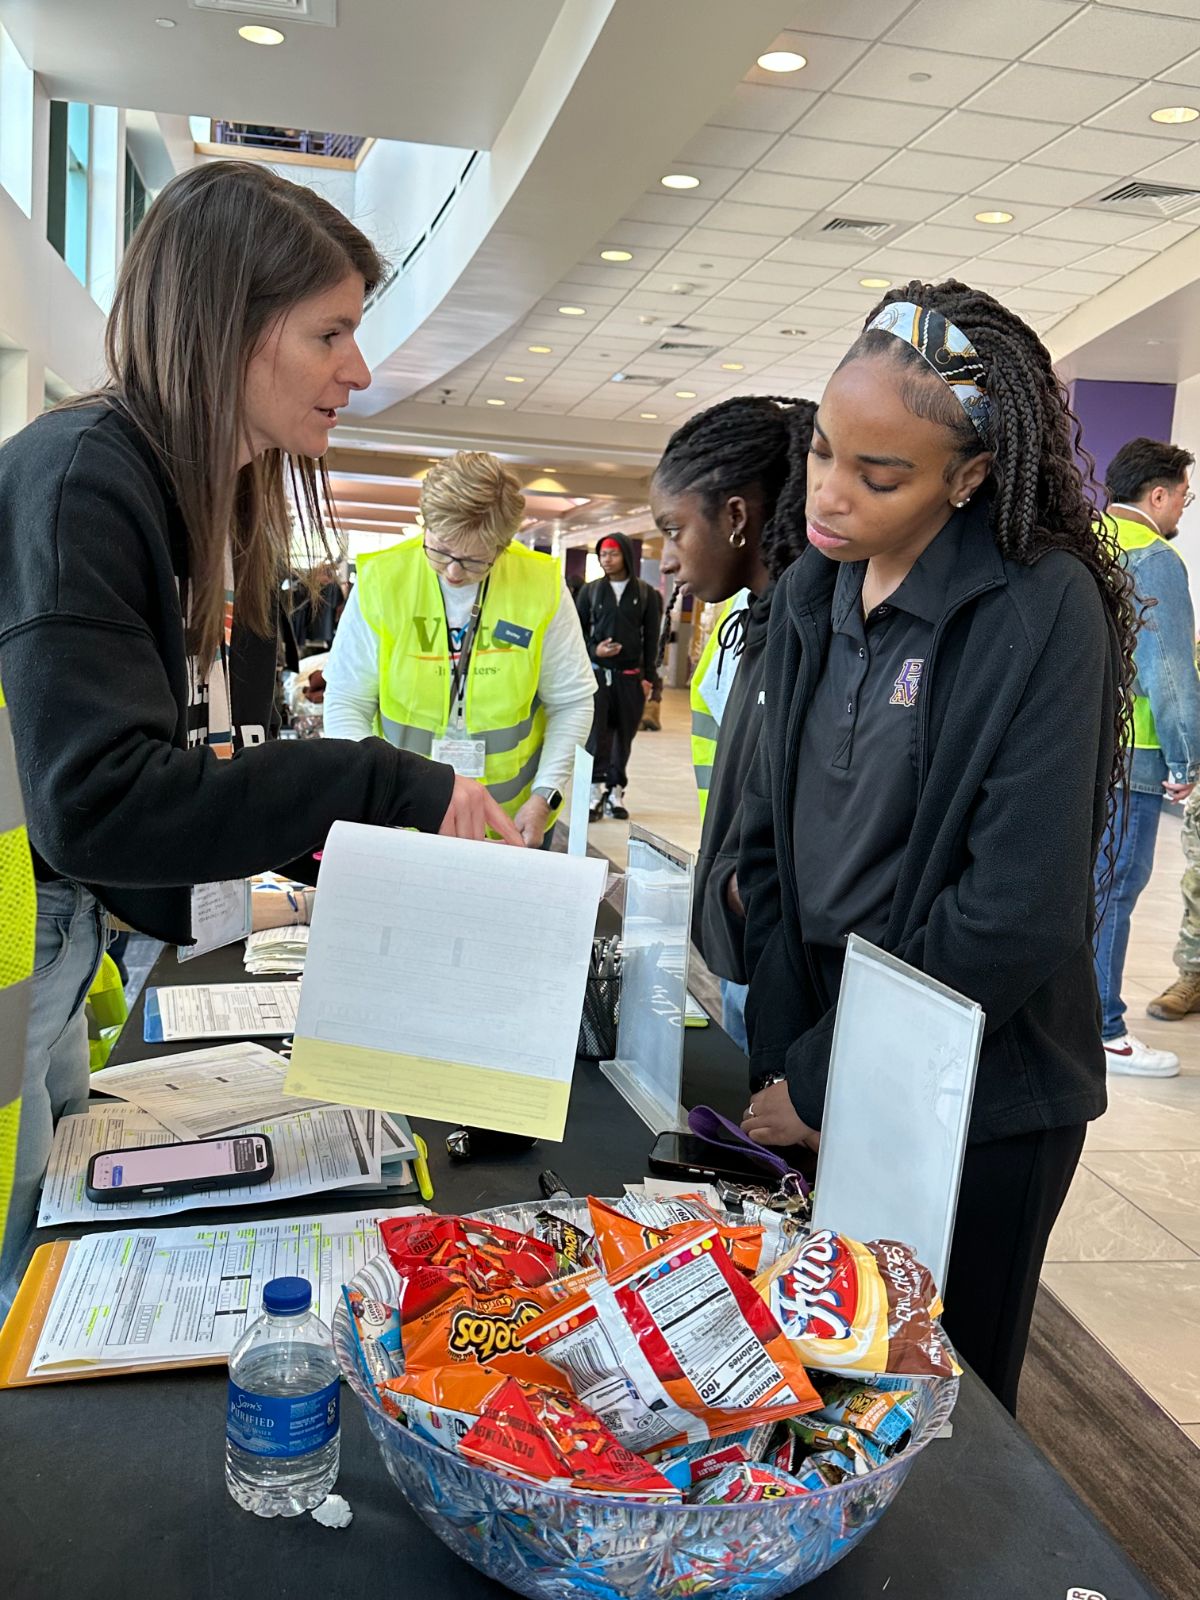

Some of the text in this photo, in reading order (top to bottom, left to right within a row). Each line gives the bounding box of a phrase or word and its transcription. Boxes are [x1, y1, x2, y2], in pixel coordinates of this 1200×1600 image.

[674, 1207, 691, 1222] 160
[699, 1339, 760, 1399] Calories 160
[754, 1357, 771, 1371] Serving
[754, 1365, 770, 1380] serving
[742, 1371, 782, 1405] Nutrition
[235, 1394, 262, 1411] Sam's
[230, 1401, 274, 1427] PURIFIED
[610, 1449, 633, 1460] 160
